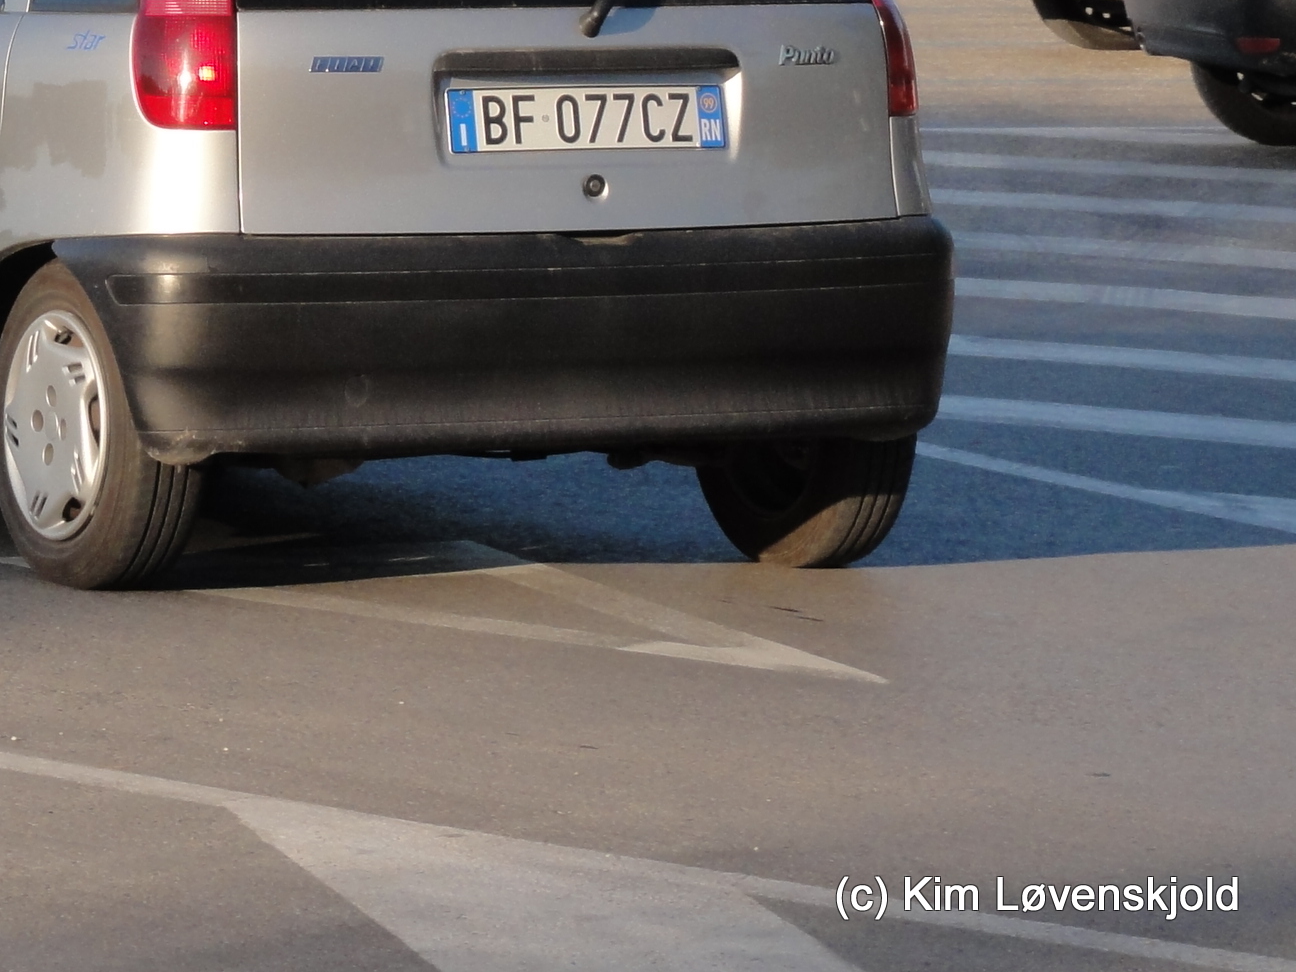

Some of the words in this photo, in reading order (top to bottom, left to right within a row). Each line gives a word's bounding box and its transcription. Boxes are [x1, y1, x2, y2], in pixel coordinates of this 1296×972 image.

[778, 44, 835, 65] Punto
[481, 94, 535, 146] BF
[555, 93, 694, 144] 077CZ
[700, 118, 722, 141] RN
